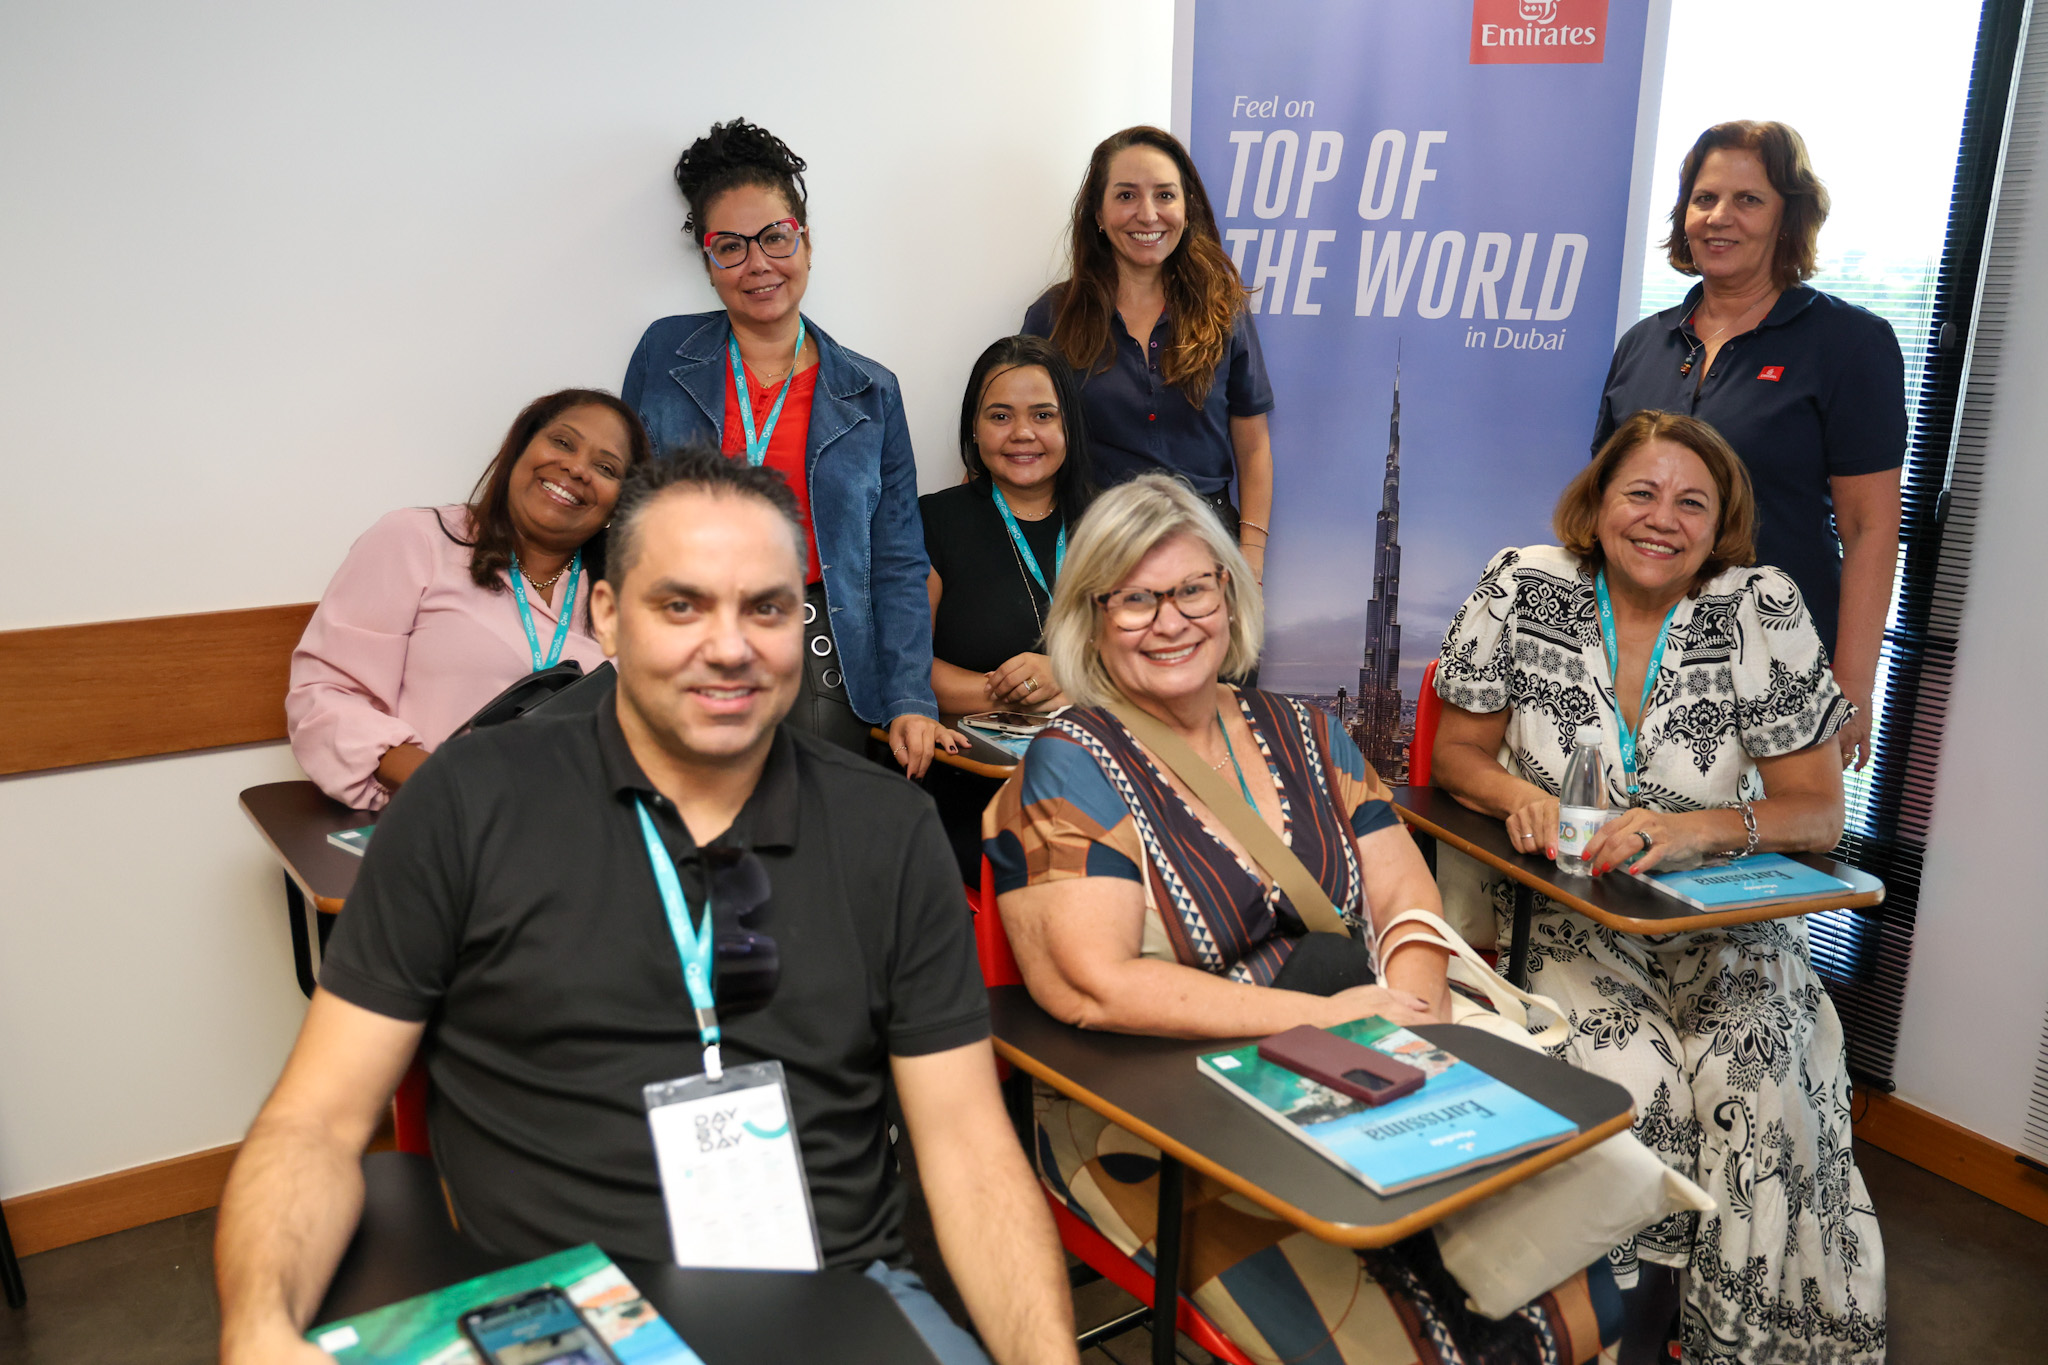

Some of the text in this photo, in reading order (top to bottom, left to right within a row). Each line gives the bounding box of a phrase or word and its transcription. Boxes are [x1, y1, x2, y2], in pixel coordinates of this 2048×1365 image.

[1482, 22, 1596, 47] Emirates
[1232, 96, 1315, 118] Feel on
[1226, 129, 1448, 220] TOP OF
[1225, 228, 1589, 321] THE WORLD
[1465, 325, 1566, 351] in Dubai
[694, 1107, 738, 1127] DAY
[1363, 1099, 1497, 1141] Eurissima
[698, 1132, 743, 1153] DAY
